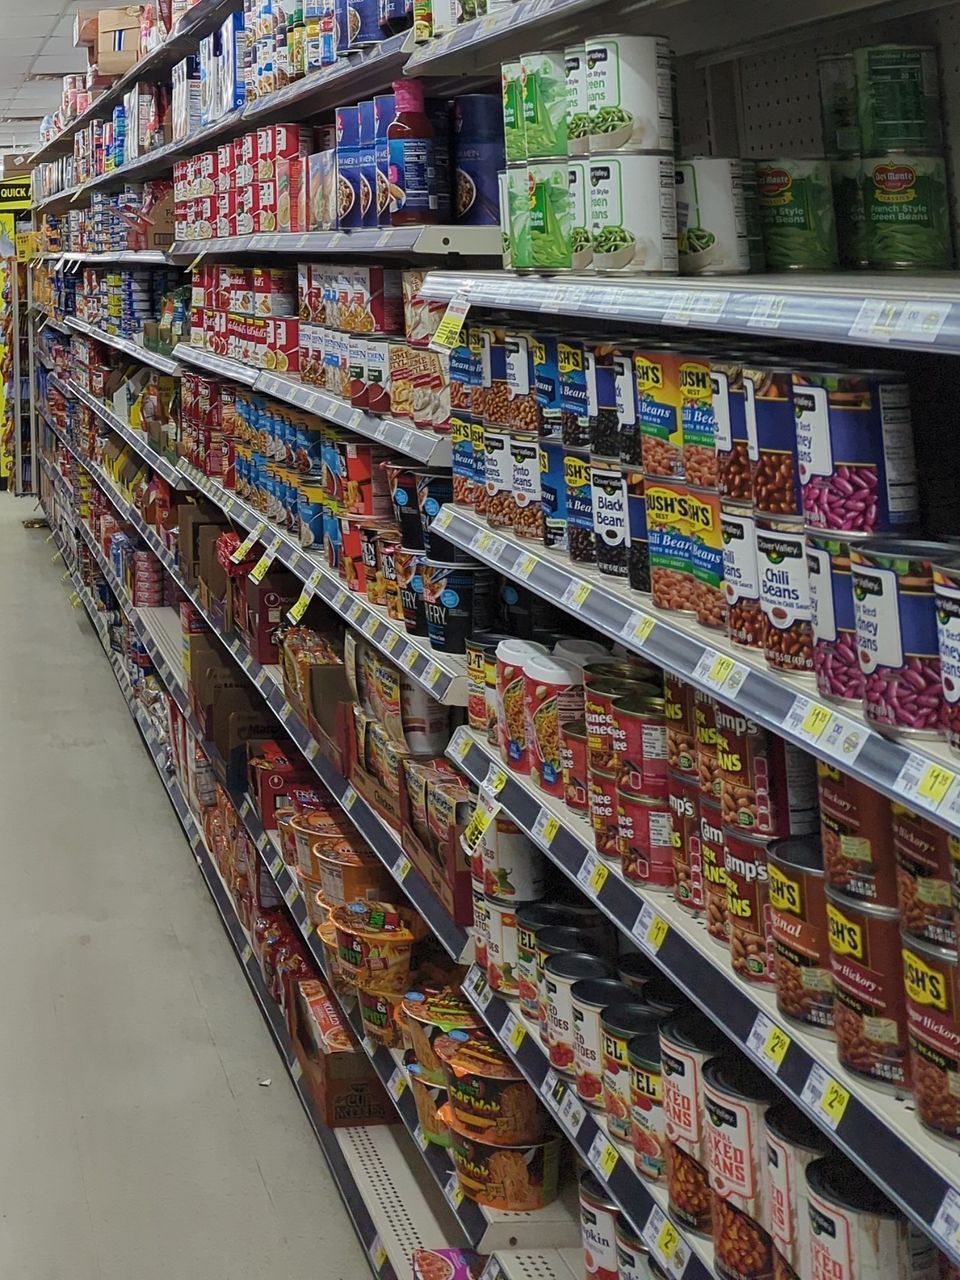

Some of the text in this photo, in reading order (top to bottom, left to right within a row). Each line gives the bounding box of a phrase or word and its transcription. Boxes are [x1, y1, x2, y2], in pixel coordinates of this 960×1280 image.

[589, 79, 605, 89] een
[588, 90, 606, 101] ans
[0, 186, 27, 197] QUICK
[592, 197, 608, 208] een
[592, 209, 609, 220] ans
[451, 358, 469, 370] Bean
[558, 349, 582, 369] SH'S
[638, 365, 661, 385] SH'S
[681, 369, 710, 388] USH'
[564, 386, 587, 400] Bean
[642, 402, 672, 419] Beans
[693, 411, 716, 425] Bea
[451, 422, 470, 440] SH'S
[456, 452, 474, 466] Bean
[565, 464, 591, 483] USH'S
[575, 499, 593, 514] Bea
[598, 495, 624, 512] Black
[689, 508, 711, 526] H'S
[765, 568, 790, 587] Chili
[762, 582, 800, 601] Beans
[701, 816, 723, 844] Cam
[770, 876, 798, 907] SH'S
[770, 911, 802, 938] ginal
[828, 920, 859, 952] SH'S
[842, 961, 877, 991] Hickory
[905, 963, 944, 1000] SH'S
[708, 1135, 745, 1165] AKED
[712, 1151, 746, 1184] ANS
[583, 1228, 610, 1249] pkin
